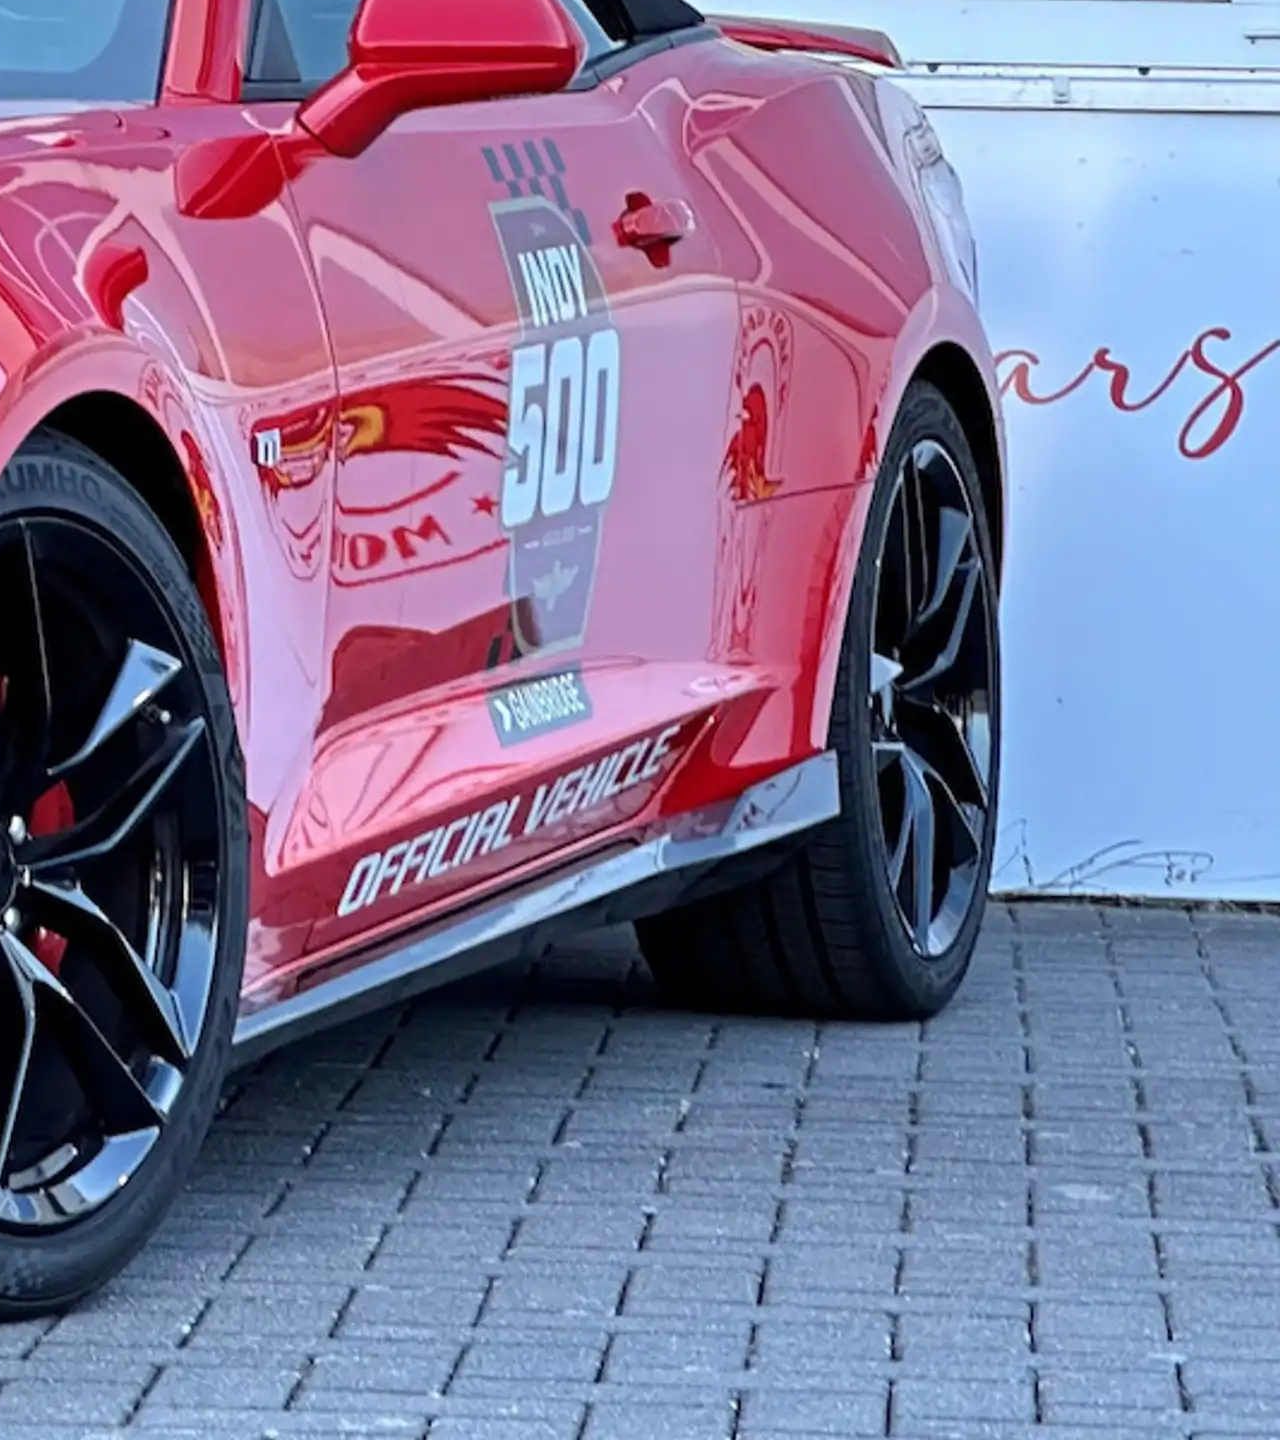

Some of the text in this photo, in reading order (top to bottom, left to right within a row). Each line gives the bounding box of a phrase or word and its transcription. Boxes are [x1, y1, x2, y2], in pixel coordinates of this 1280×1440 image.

[517, 242, 588, 328] INDY
[501, 328, 619, 528] 500
[336, 725, 680, 918] OFFICIAL VEHICLE
